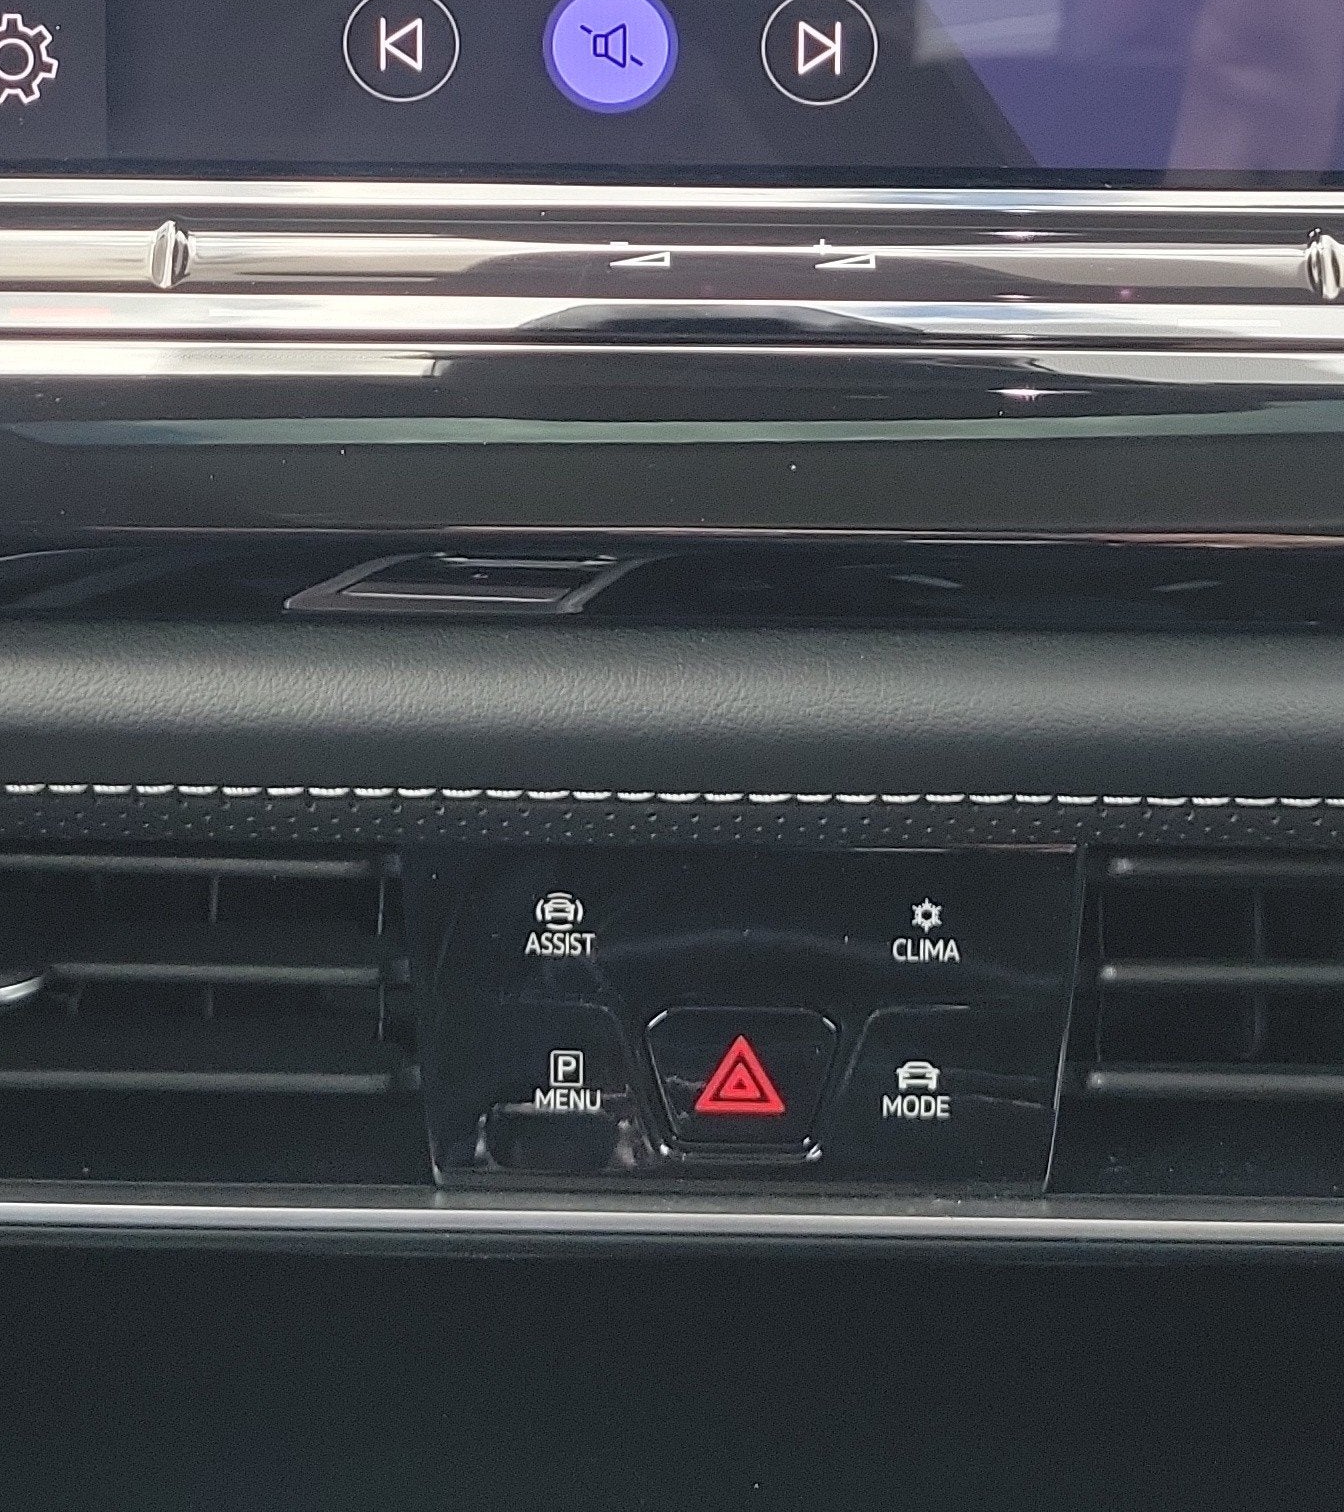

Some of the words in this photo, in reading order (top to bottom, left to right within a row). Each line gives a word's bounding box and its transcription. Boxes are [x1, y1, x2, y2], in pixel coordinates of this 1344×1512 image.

[524, 932, 596, 956] ASSIST
[891, 937, 960, 962] CLIMA
[535, 1088, 602, 1111] MENU
[881, 1094, 951, 1118] MODE
